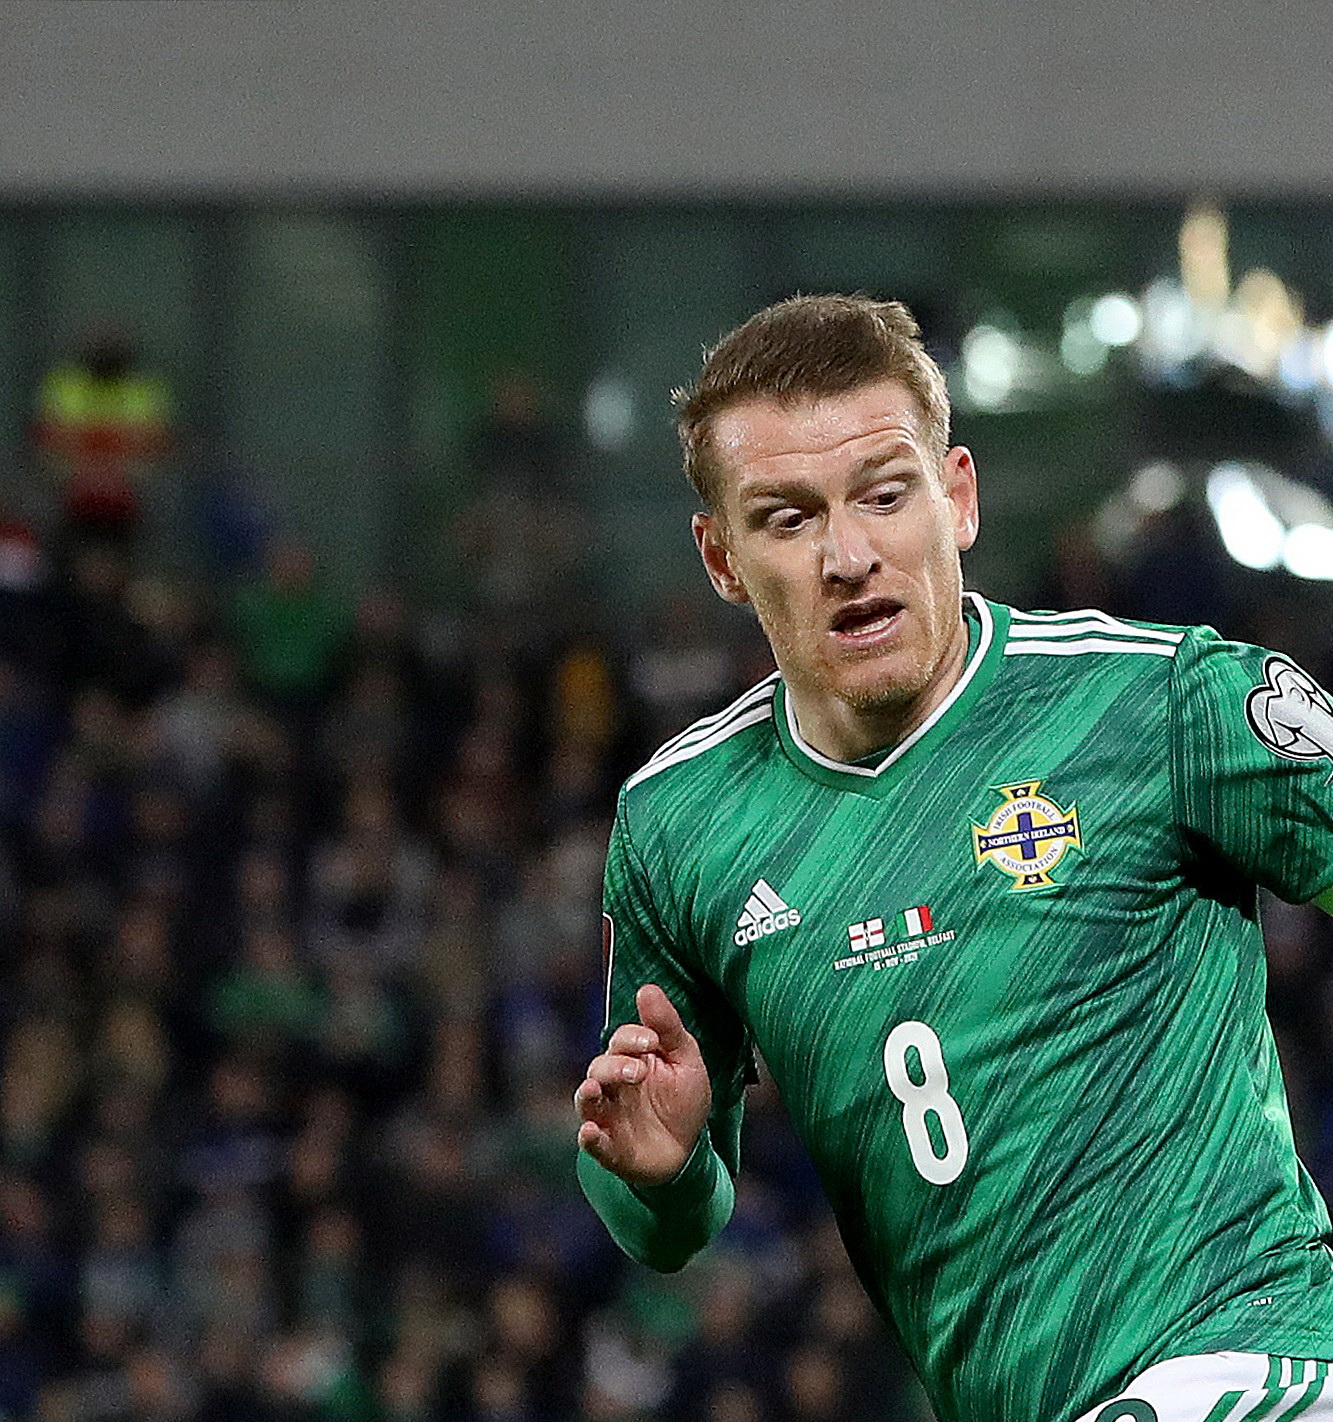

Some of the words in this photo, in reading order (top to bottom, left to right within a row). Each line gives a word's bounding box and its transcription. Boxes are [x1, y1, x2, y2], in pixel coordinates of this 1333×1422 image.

[1000, 847, 1058, 872] ASSOCIATION
[734, 908, 801, 946] adidas
[884, 1020, 970, 1186] 8
